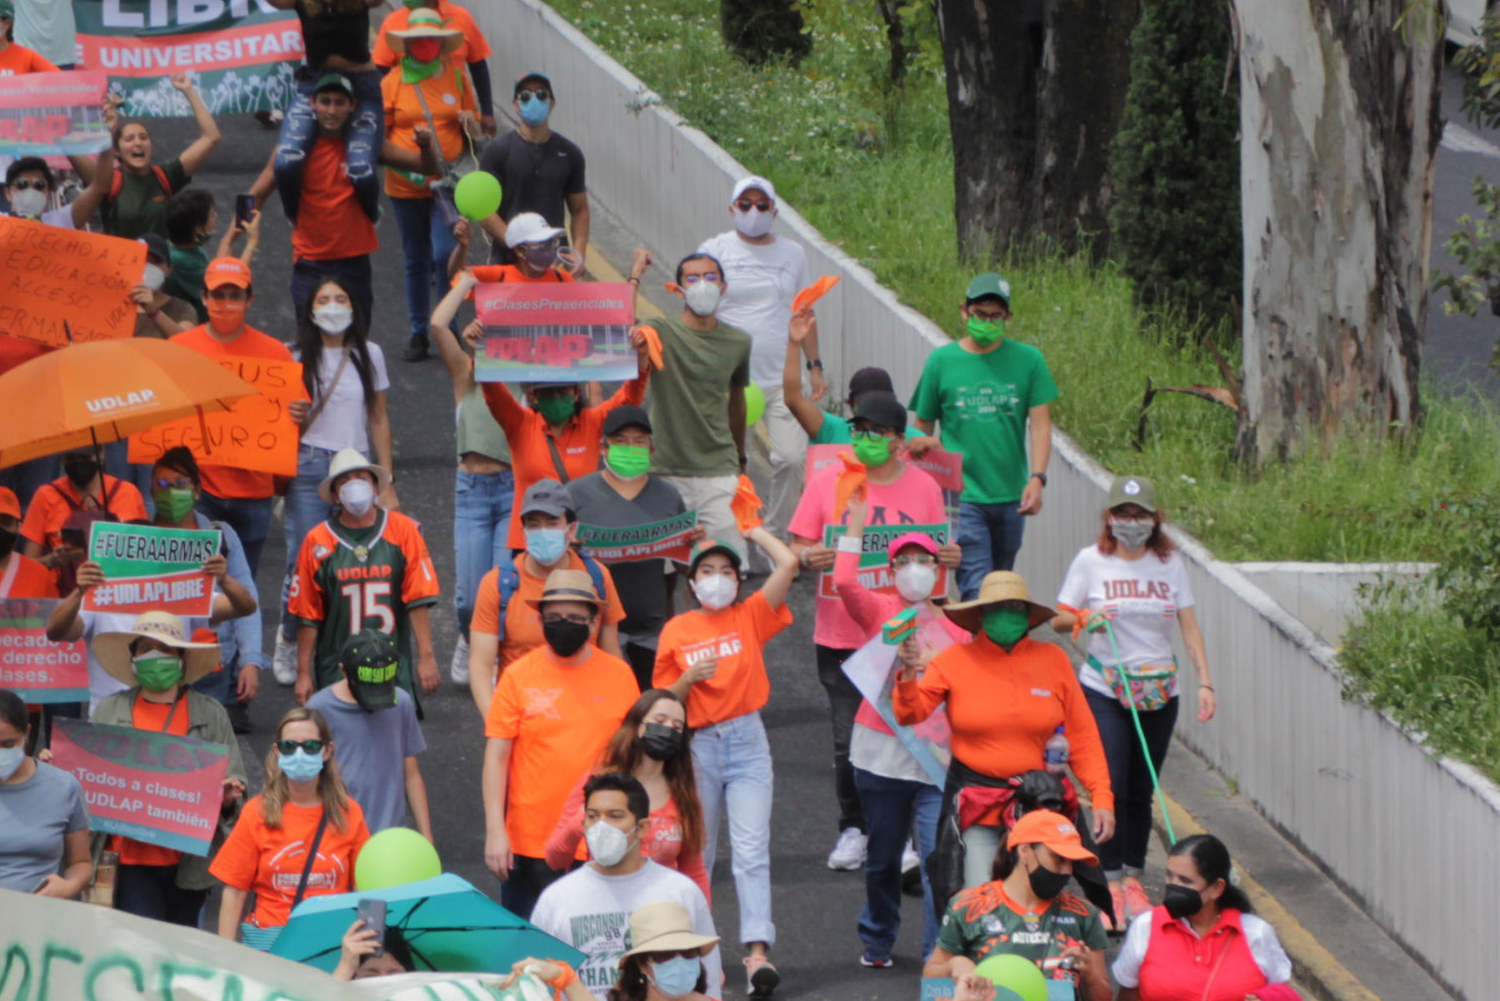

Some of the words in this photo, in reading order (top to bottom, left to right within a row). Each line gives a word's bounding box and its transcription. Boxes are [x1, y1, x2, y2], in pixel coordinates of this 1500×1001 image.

[99, 248, 110, 261] A
[117, 252, 140, 267] LA
[7, 275, 92, 310] ACCESO
[484, 298, 625, 312] #ClasesPresenciales
[84, 388, 157, 413] UDLAP
[139, 425, 279, 460] SEGURO
[582, 516, 693, 543] #FUERAARMAS
[95, 533, 214, 564] #FUERAARMAS
[336, 564, 393, 582] UDLAP
[92, 577, 205, 607] #UDLAPLIBRE
[1102, 579, 1171, 601] UDLAP
[341, 581, 397, 636] 15
[3, 649, 82, 666] derecho
[72, 767, 127, 789] ¡Todos
[131, 779, 141, 792] a
[145, 782, 202, 805] clases!
[85, 790, 145, 814] UDLAP
[148, 803, 213, 831] también.
[570, 911, 626, 949] WISCONSIN
[604, 928, 621, 941] 98
